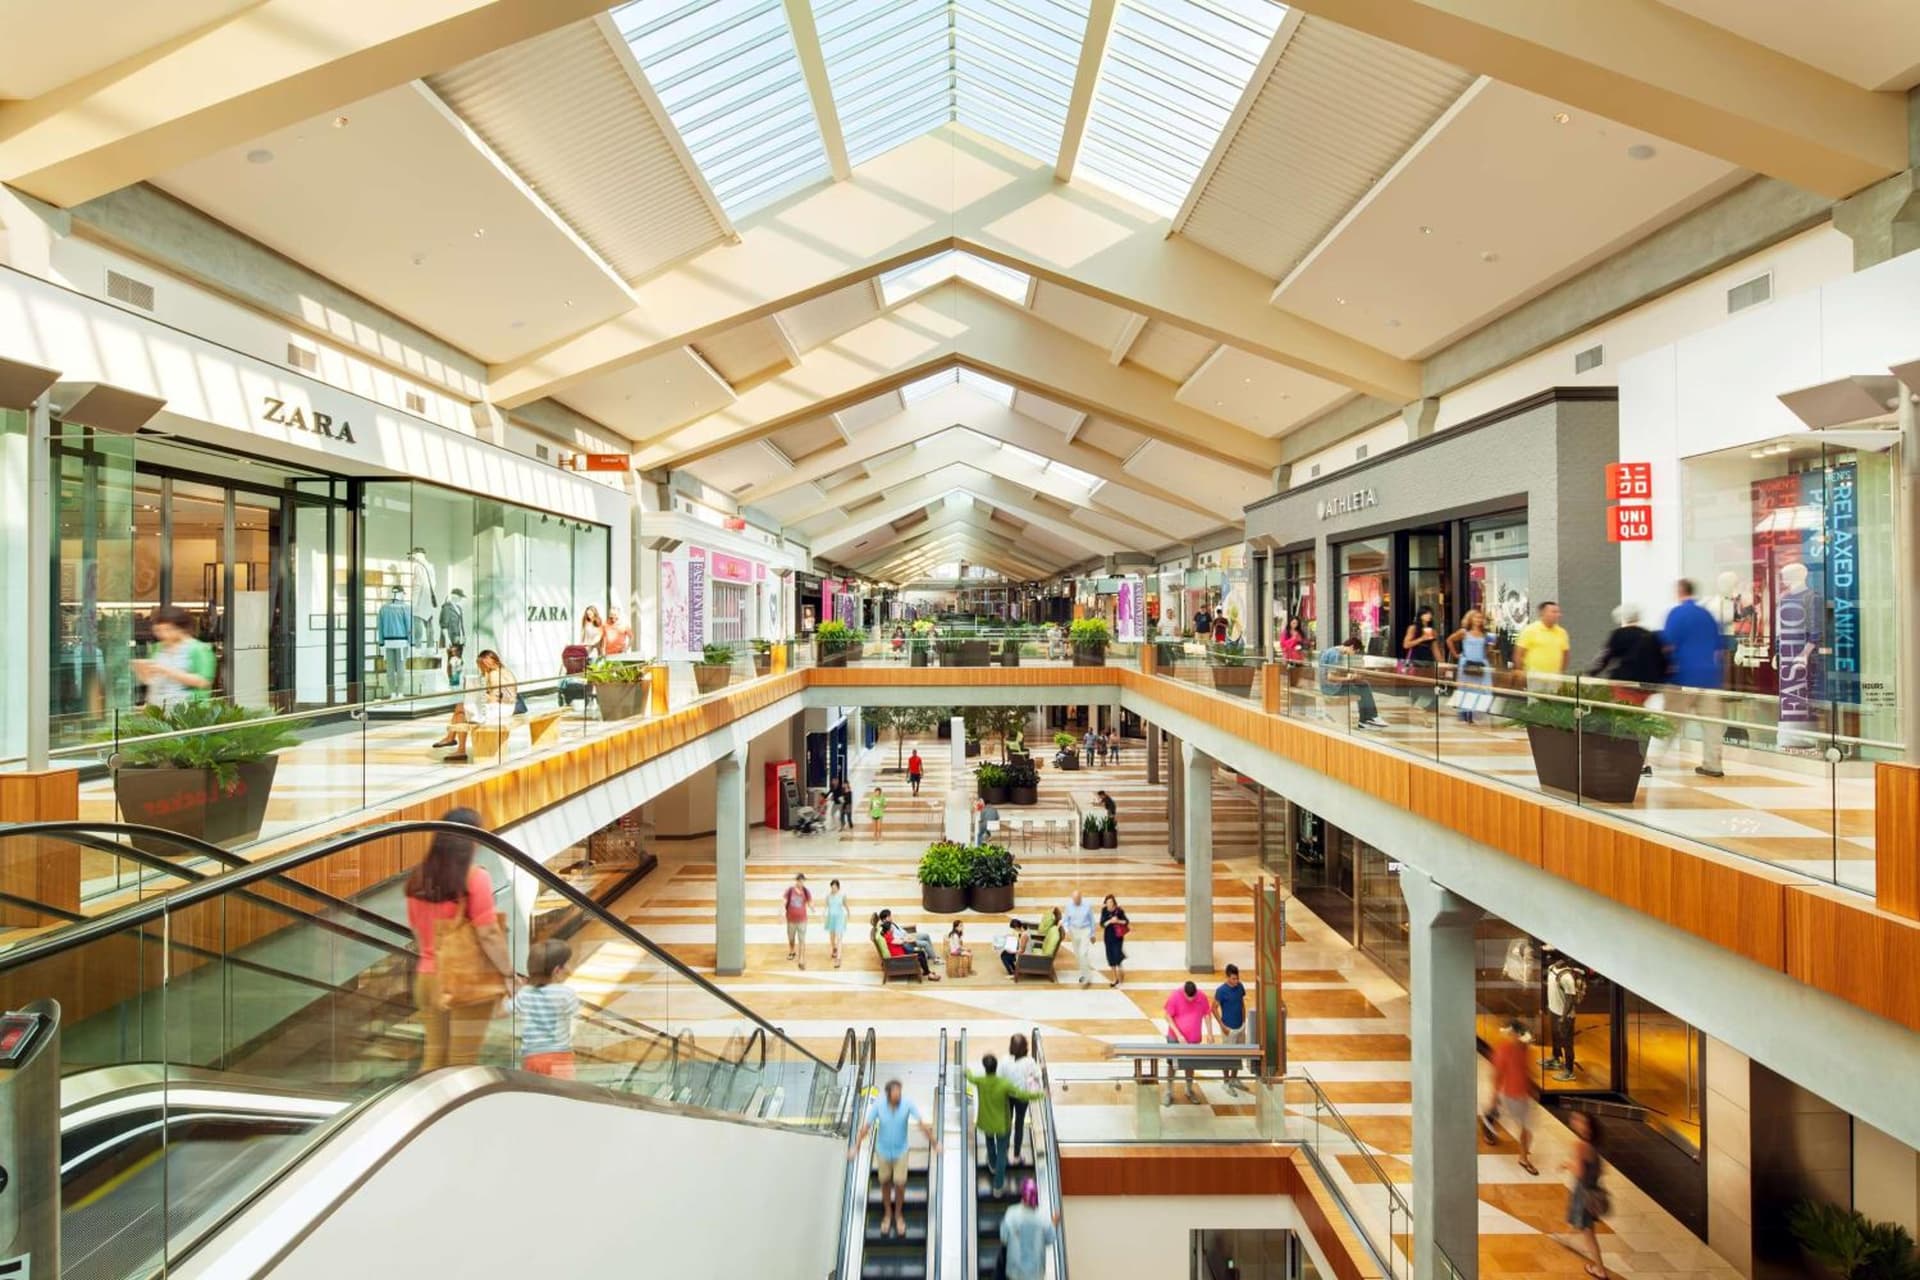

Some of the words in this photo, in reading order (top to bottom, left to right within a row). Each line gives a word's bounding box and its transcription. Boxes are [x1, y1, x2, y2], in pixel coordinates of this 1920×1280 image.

[262, 396, 357, 444] ZARA
[1325, 487, 1376, 517] ATHLETA
[1619, 509, 1646, 523] UNI
[1620, 523, 1649, 539] QLO
[1832, 486, 1854, 589] RELAXED
[527, 606, 568, 621] ZARA
[1833, 597, 1855, 673] ANKLE
